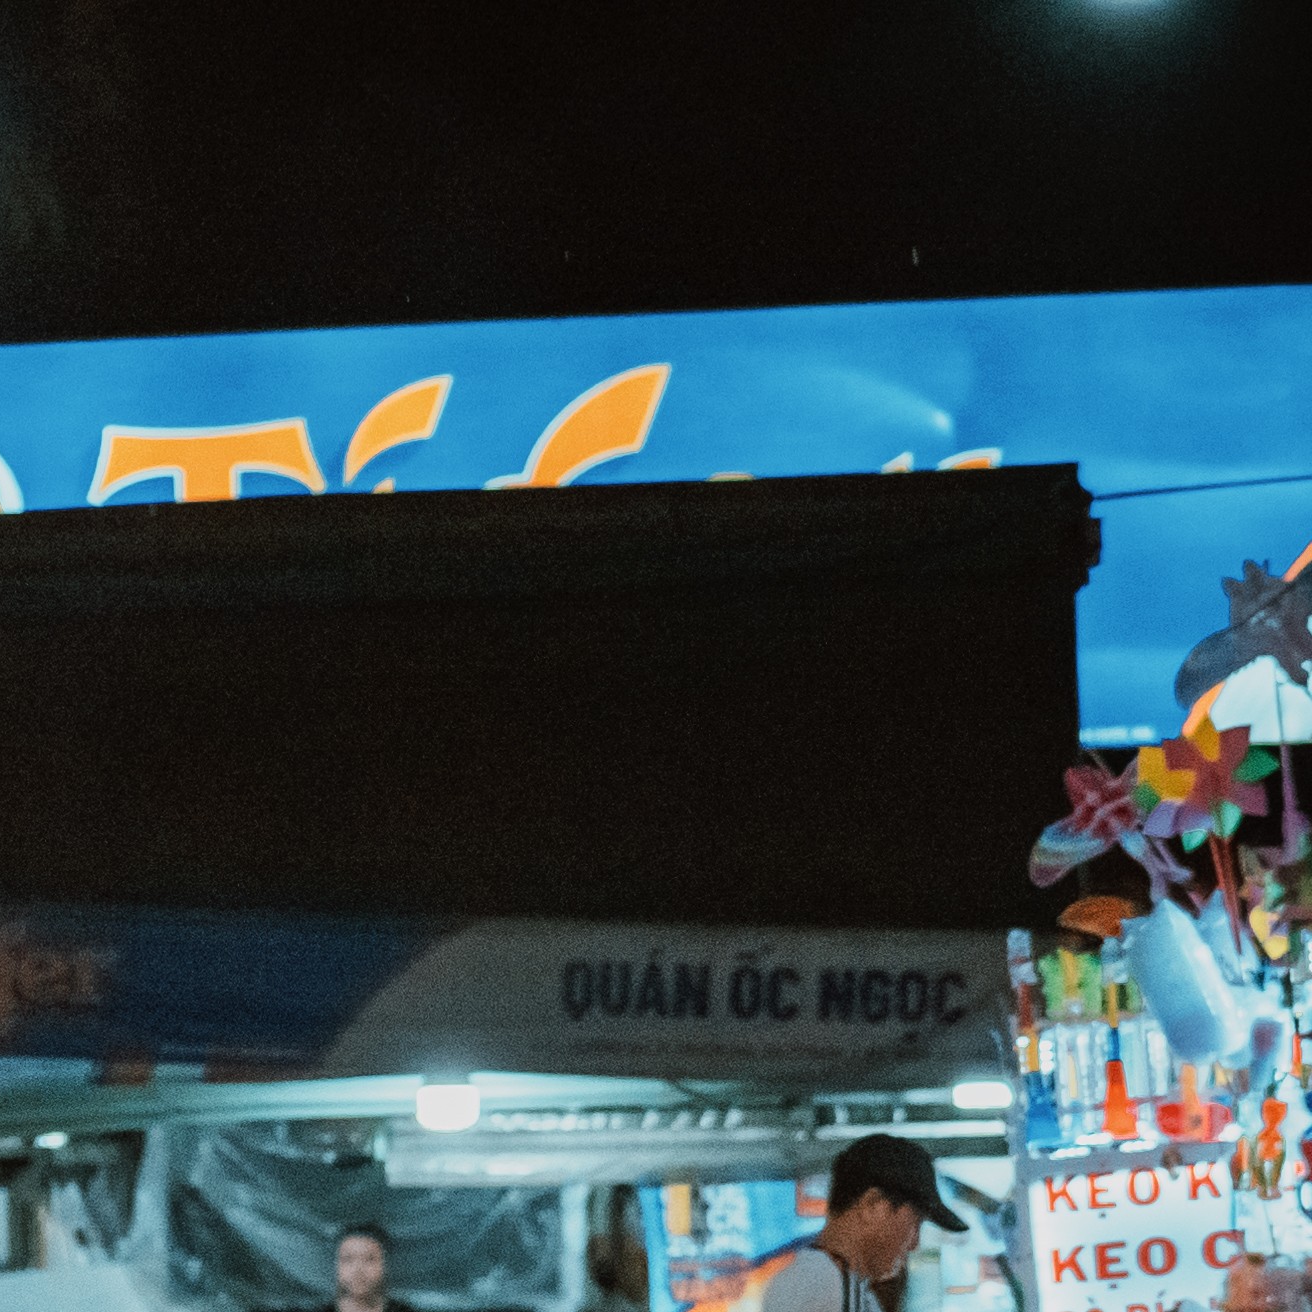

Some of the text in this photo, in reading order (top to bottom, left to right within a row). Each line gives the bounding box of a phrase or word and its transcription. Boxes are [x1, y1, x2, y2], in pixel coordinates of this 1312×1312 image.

[560, 944, 968, 1043] QUÁN ỐC NGỌC
[1044, 1166, 1161, 1219] KẸO
[1051, 1236, 1178, 1290] KẸO
